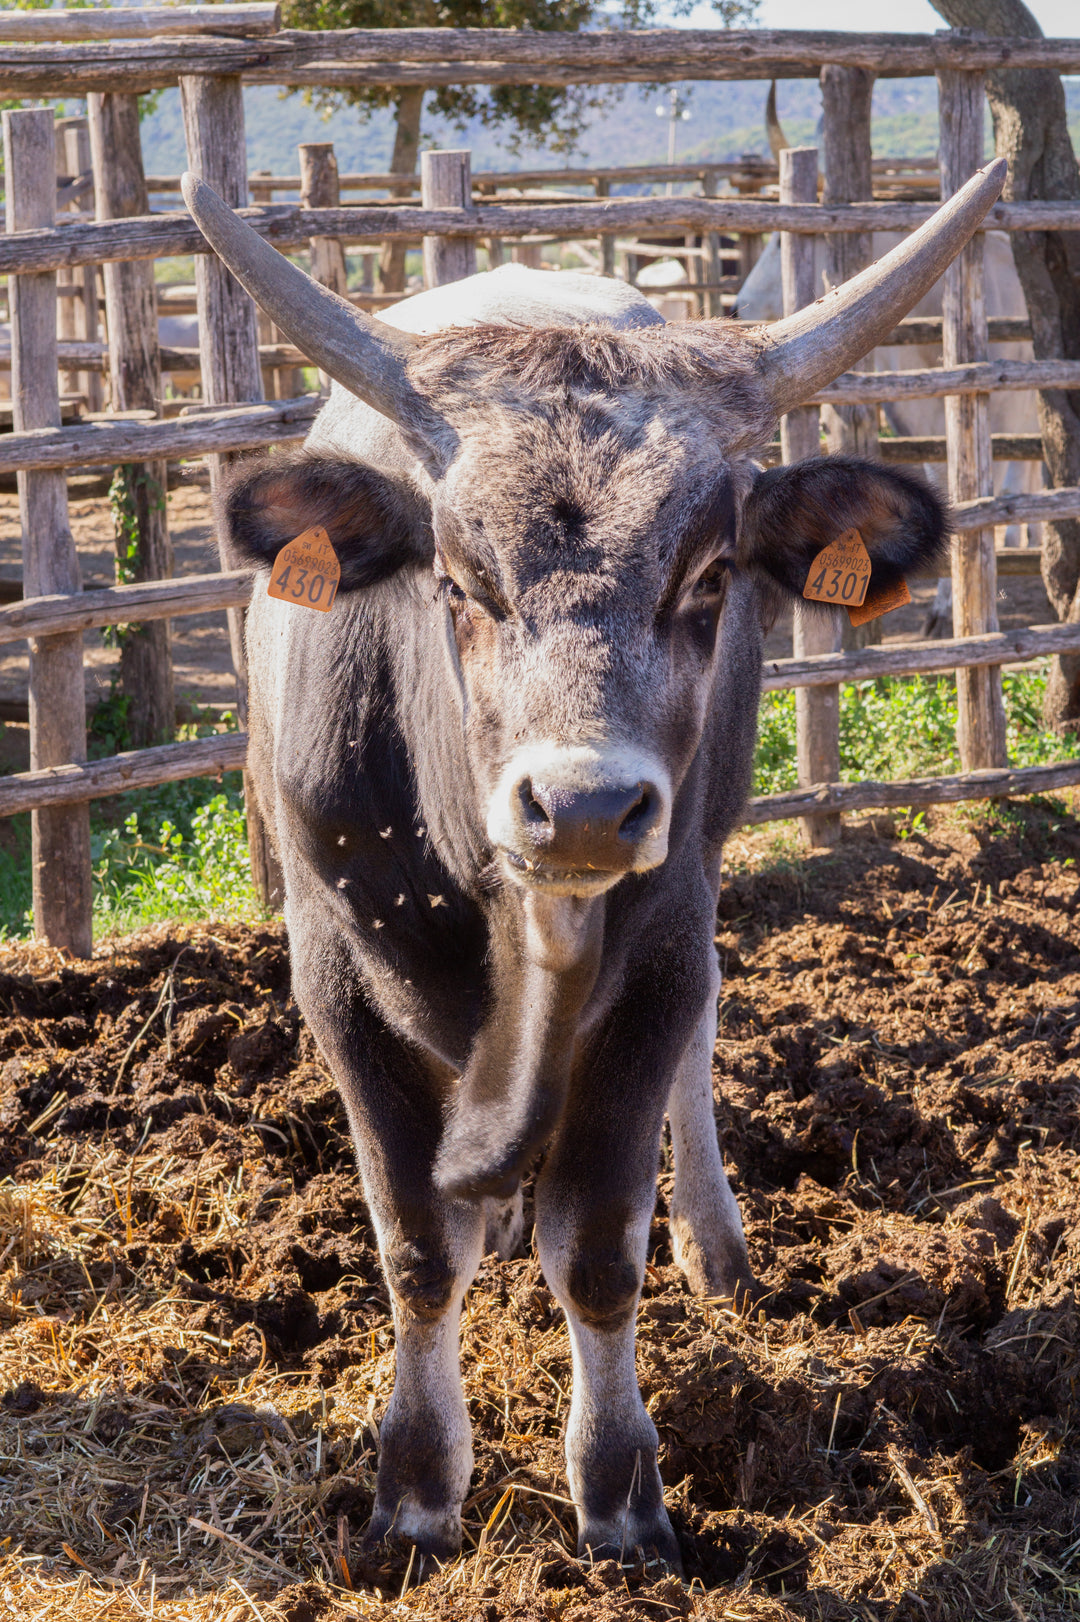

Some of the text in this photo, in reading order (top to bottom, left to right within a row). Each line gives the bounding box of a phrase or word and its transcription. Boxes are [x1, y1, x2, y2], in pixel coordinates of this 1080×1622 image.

[318, 544, 330, 555] IT
[851, 543, 863, 553] IT
[283, 549, 338, 575] 05699023
[819, 552, 869, 572] 05699023
[276, 565, 338, 607] 4301
[811, 568, 868, 602] 4301
